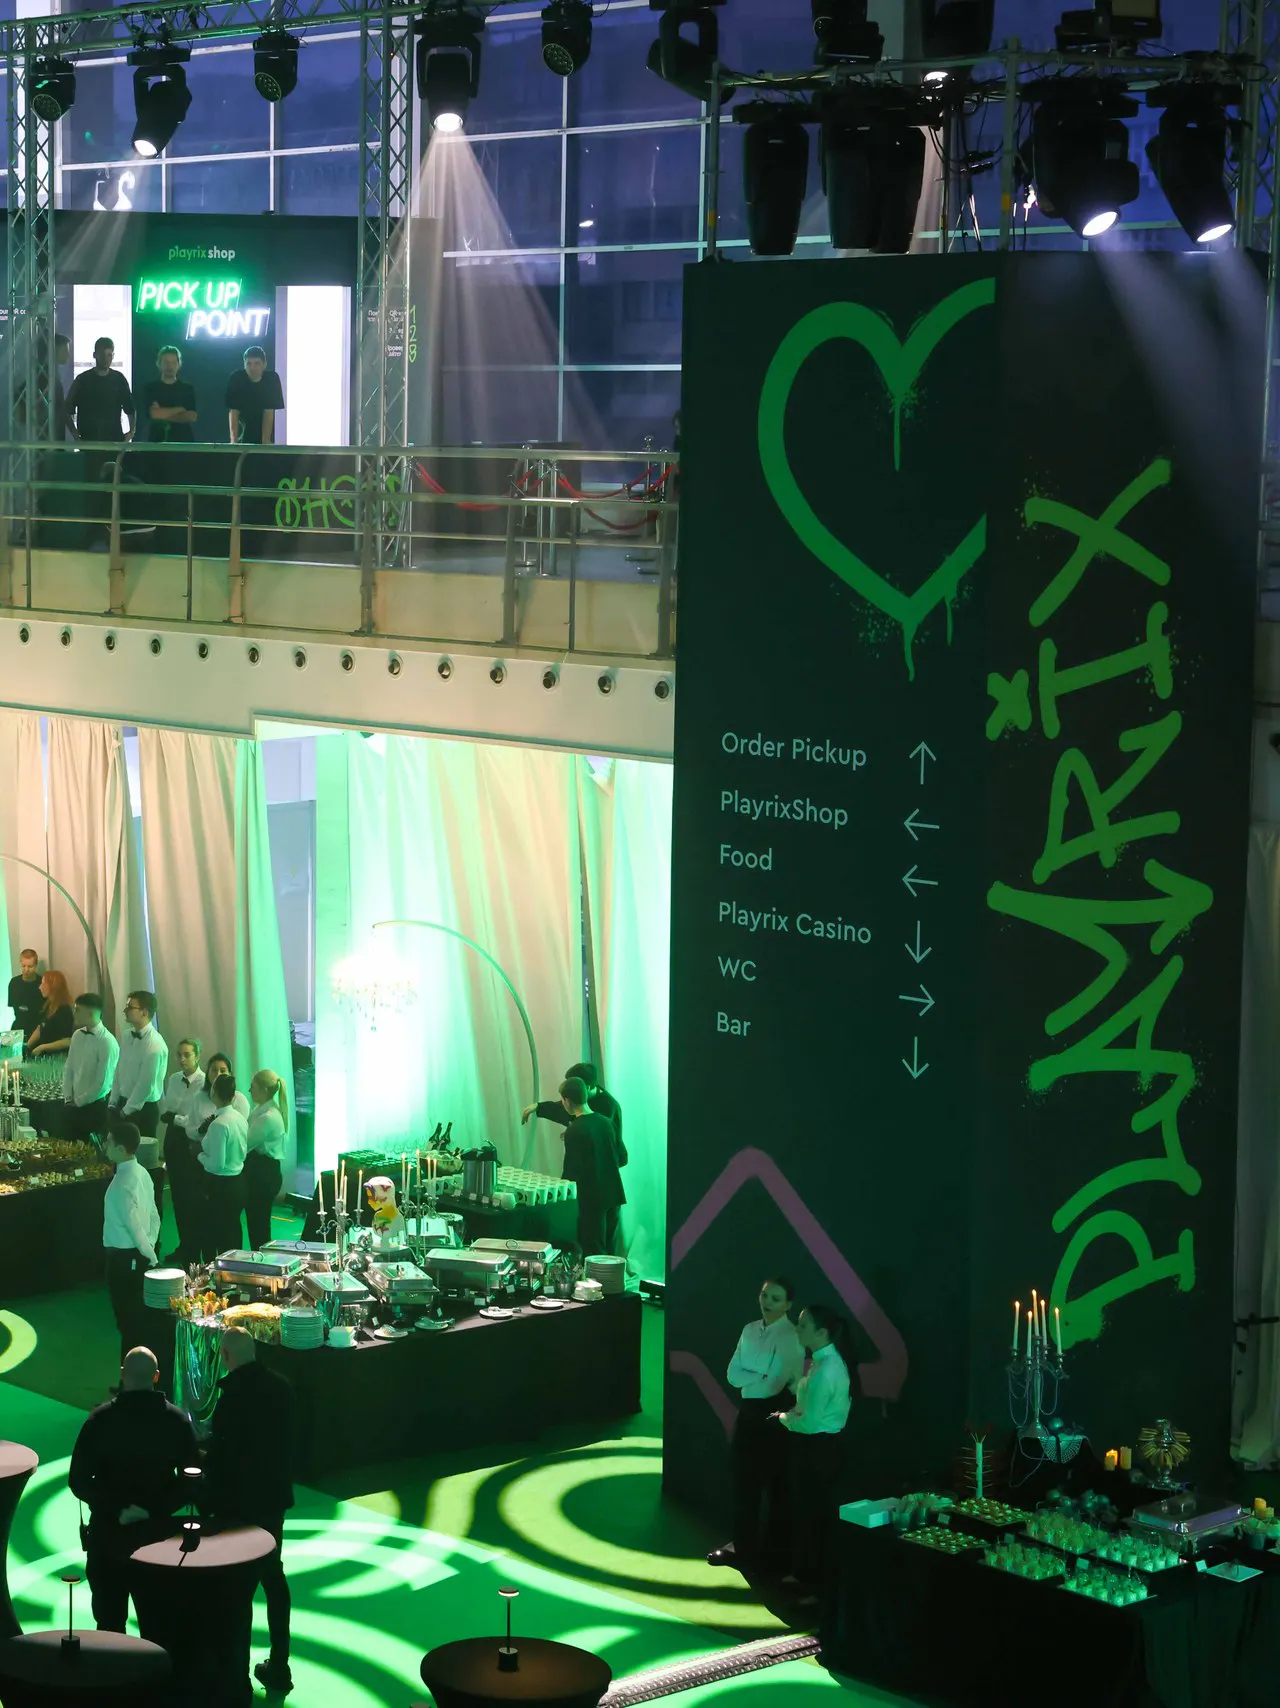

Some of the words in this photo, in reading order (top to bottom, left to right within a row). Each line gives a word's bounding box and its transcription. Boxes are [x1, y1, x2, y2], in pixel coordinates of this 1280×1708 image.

[140, 281, 200, 310] PICK
[205, 281, 240, 309] UP
[189, 309, 270, 337] POINT
[409, 304, 417, 323] 1
[409, 324, 417, 342] 2
[721, 732, 785, 758] Order
[792, 737, 867, 770] Pickup
[721, 789, 848, 830] PlayrixShop
[720, 844, 773, 871] Food
[986, 457, 1214, 1349] PLAYRIX
[719, 901, 789, 932] Playrix
[796, 913, 872, 944] Casino
[717, 956, 757, 981] WC
[717, 1011, 751, 1036] Bar
